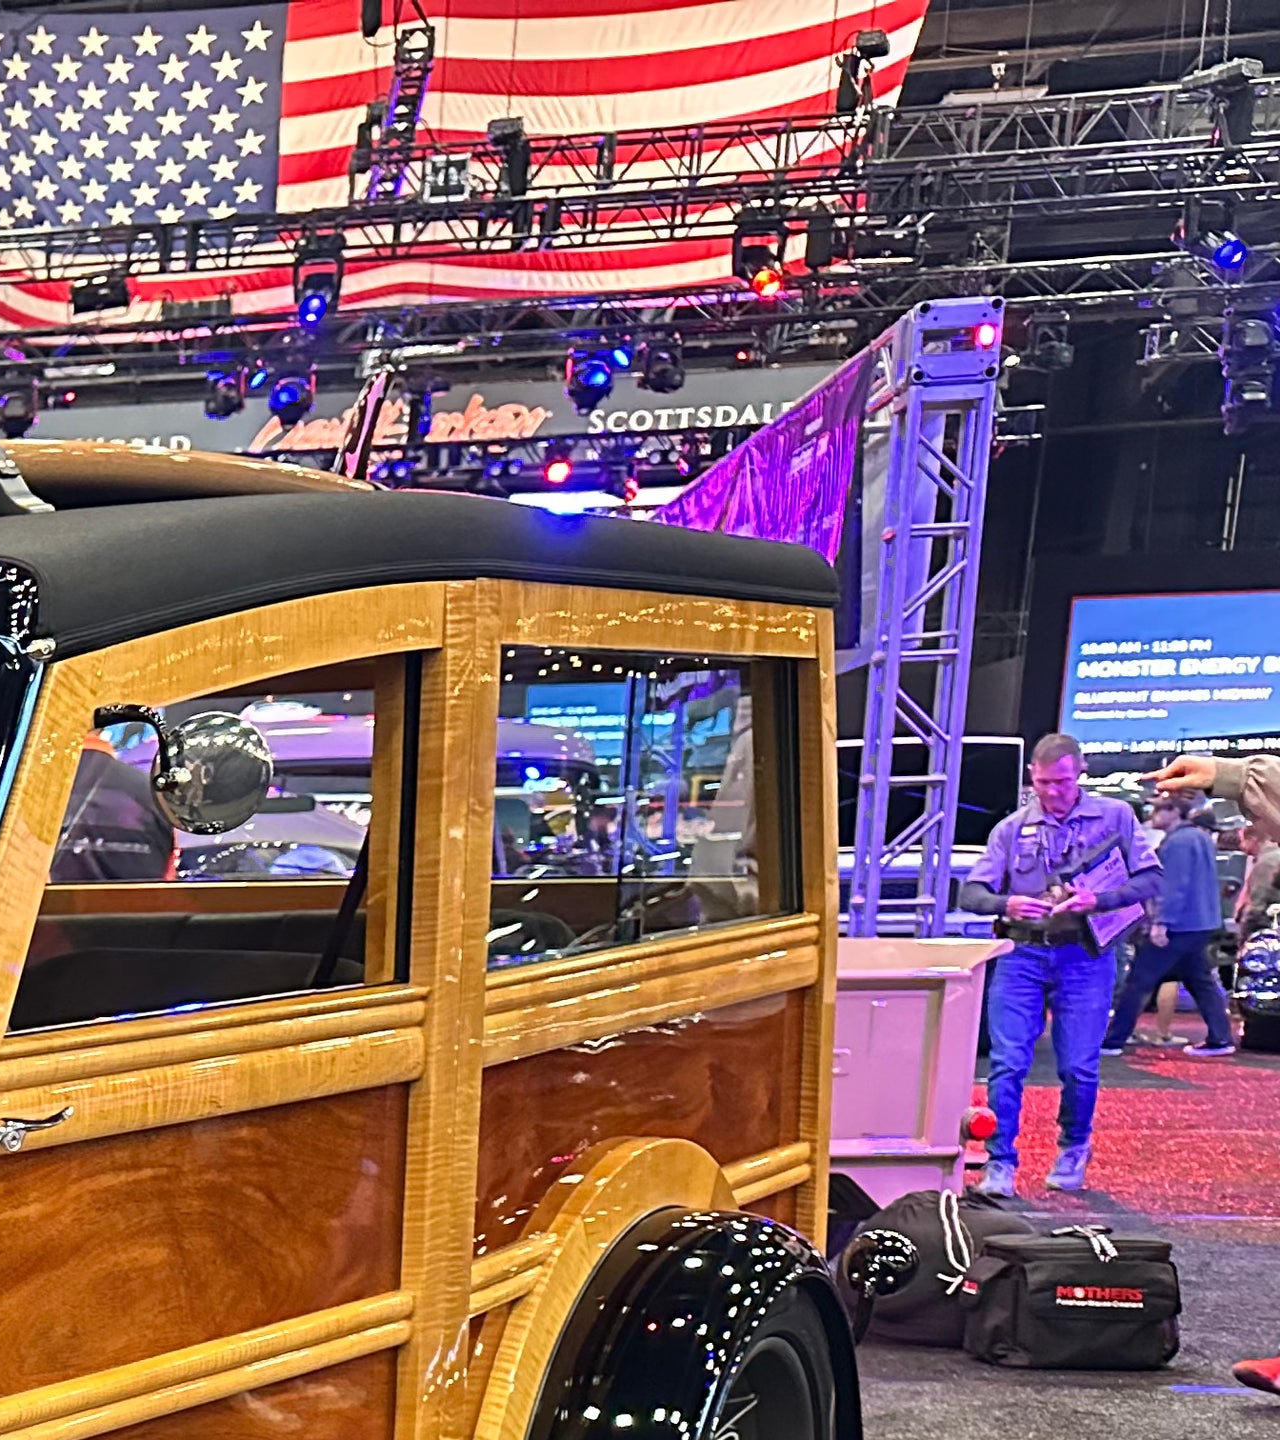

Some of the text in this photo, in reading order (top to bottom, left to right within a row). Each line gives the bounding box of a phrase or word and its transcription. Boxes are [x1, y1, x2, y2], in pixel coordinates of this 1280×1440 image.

[1077, 658, 1176, 678] MONSTER
[1180, 656, 1261, 676] ENERGY
[1056, 1286, 1143, 1300] MOTHERS
